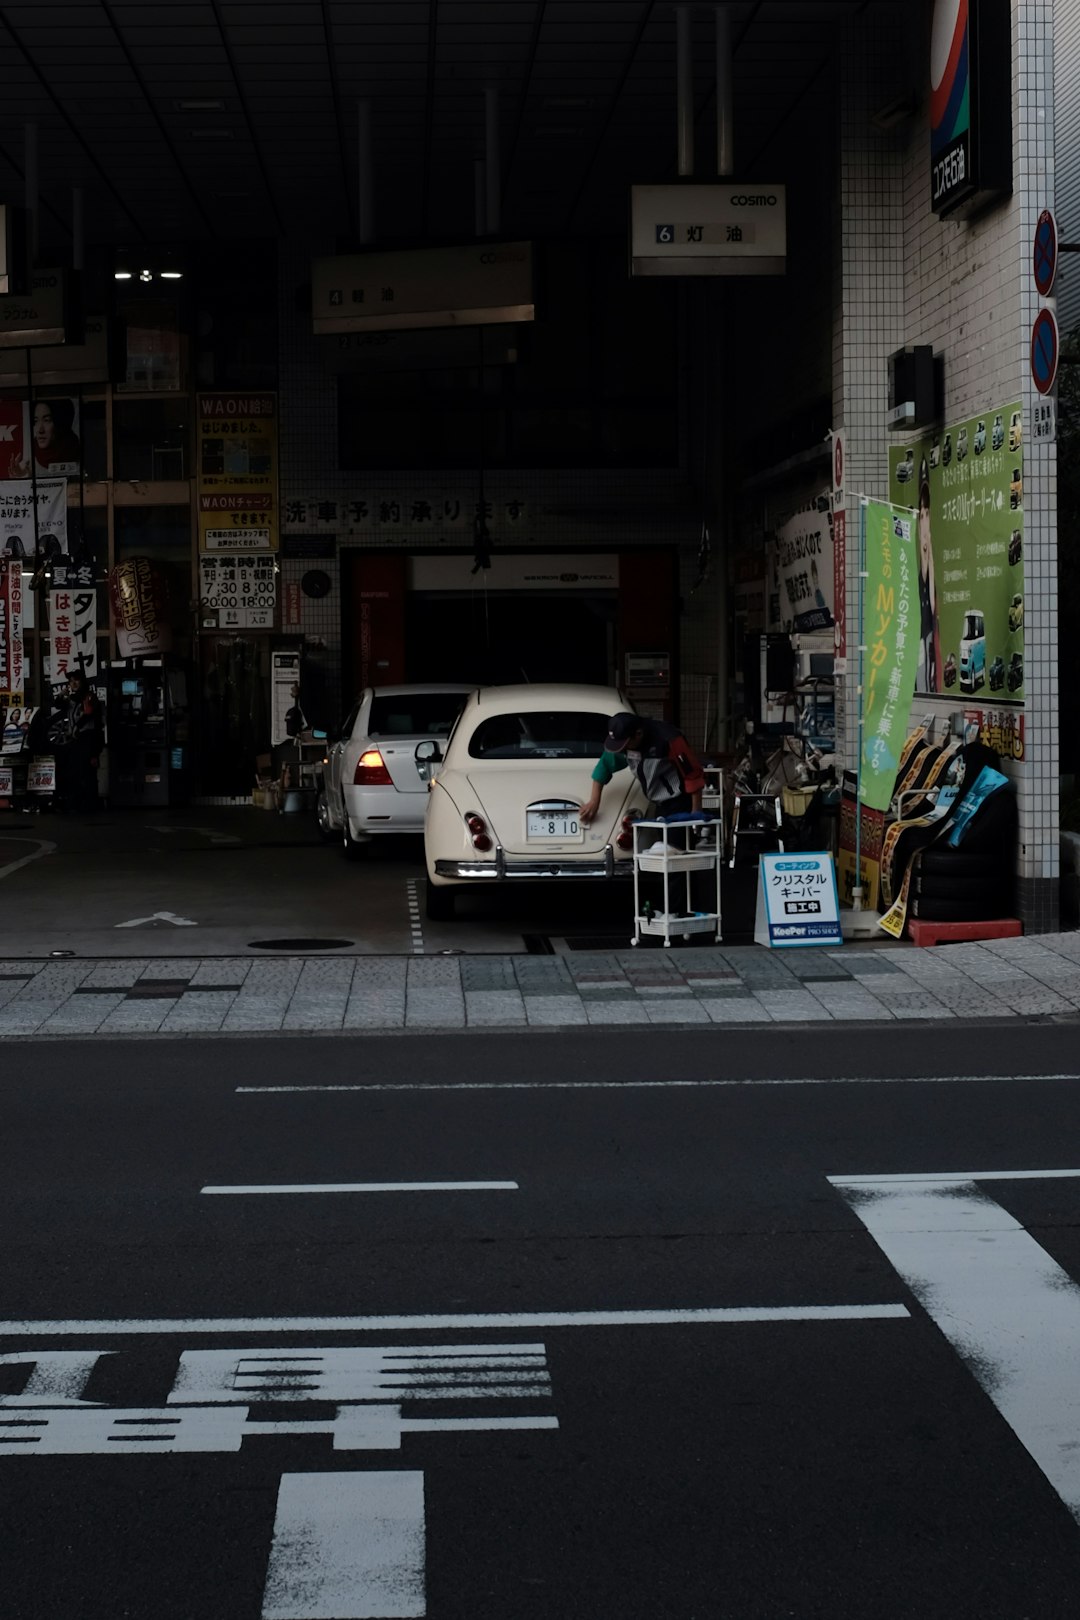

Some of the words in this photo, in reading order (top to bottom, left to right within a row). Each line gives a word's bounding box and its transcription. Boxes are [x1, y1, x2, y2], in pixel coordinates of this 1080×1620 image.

[933, 143, 965, 200] コスモ石油
[730, 195, 777, 206] COSMO
[659, 226, 671, 242] 6
[687, 226, 742, 242] 灯油
[202, 497, 271, 508] WAONチャージ
[286, 500, 525, 522] 洗車予約承ります
[201, 556, 274, 569] 営業時間
[53, 567, 69, 585] 夏
[78, 566, 93, 585] 冬
[205, 582, 237, 594] 7:30
[242, 582, 274, 594] 8:00
[55, 593, 71, 676] はき替え
[73, 593, 93, 677] タイヤ
[772, 874, 827, 886] クリスタル
